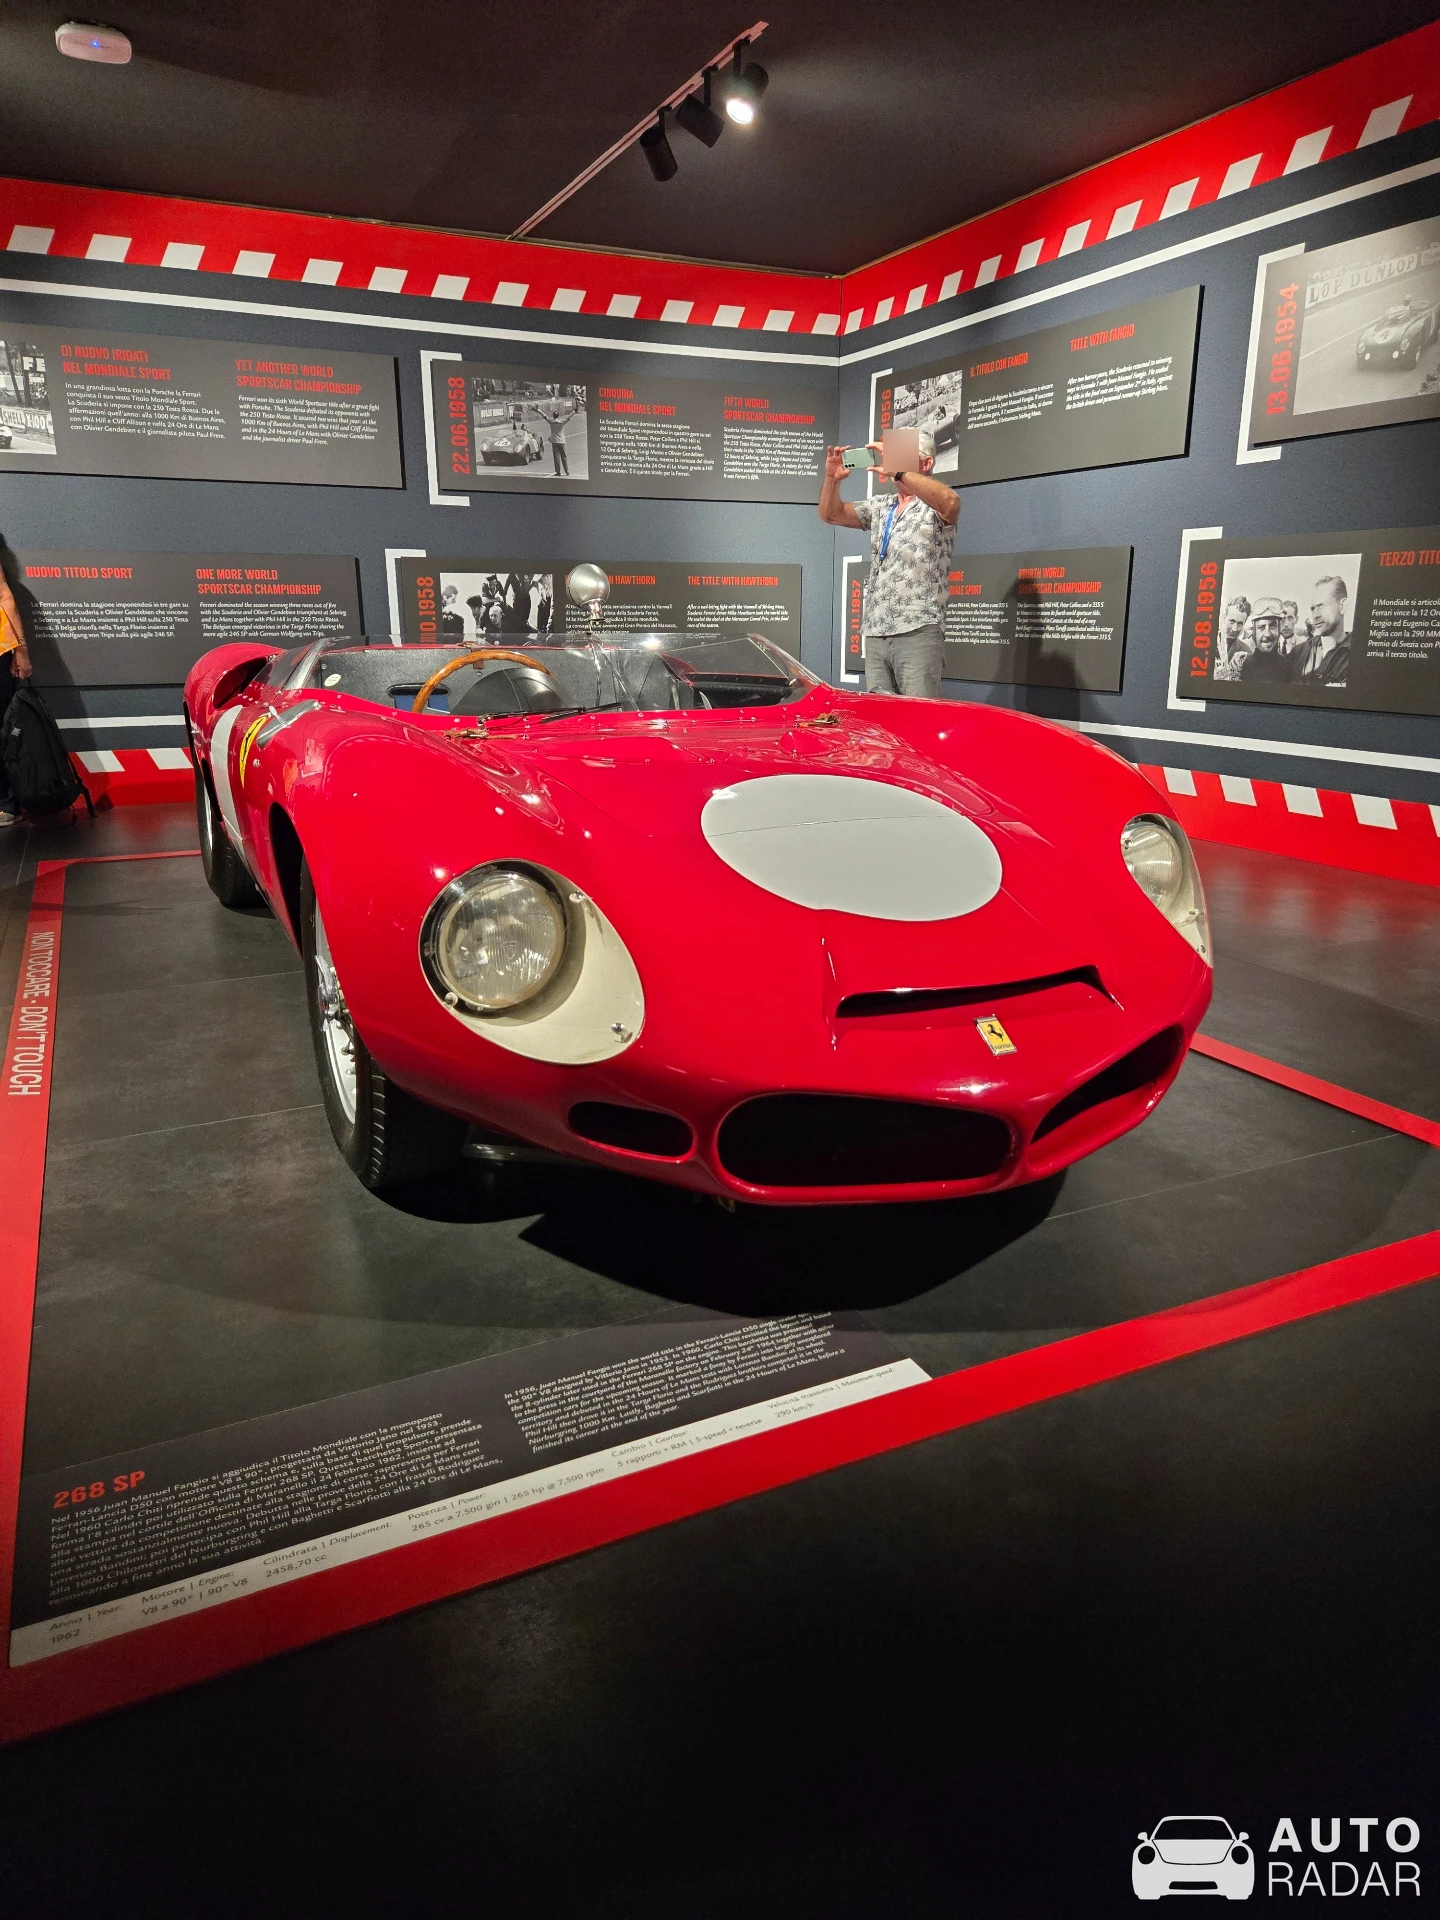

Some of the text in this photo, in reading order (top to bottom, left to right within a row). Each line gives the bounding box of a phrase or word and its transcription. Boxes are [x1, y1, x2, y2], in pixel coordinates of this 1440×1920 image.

[1350, 256, 1415, 288] DUNLOP
[1070, 323, 1135, 352] TITLE WITH FANGIO
[61, 345, 149, 362] DI NUOVO IRIDATI
[1266, 282, 1299, 416] 13.06.1954
[63, 361, 171, 381] NEL MONDIALE SPORT
[235, 359, 334, 378] YET ANOTHER WORLD
[975, 362, 995, 377] TITOLO
[995, 358, 1007, 371] CON
[1007, 352, 1029, 368] FANGIO
[65, 382, 71, 390] In
[86, 384, 116, 394] grandiosa
[145, 387, 150, 395] la
[152, 388, 175, 396] Porsche
[176, 389, 181, 397] la
[182, 390, 201, 398] Ferrari
[236, 375, 361, 395] SPORTSCAR CHAMPIONSHIP
[599, 387, 634, 399] CINQUINA
[599, 401, 676, 416] NEL MONDIALE SPORT
[723, 396, 769, 409] FIFTH WORLD
[448, 377, 470, 475] 22.06.1958
[723, 410, 815, 425] SPORTSCAR CHAMPIONSHIP
[1380, 551, 1415, 566] TERZO
[26, 566, 133, 579] NUOVO TITOLO SPORT
[196, 569, 278, 580] ONE MORE WORLD
[615, 576, 656, 585] HAWTHORN
[688, 576, 779, 586] THE TITLE WITH HAWTHORN
[1018, 567, 1065, 579] FOURTH WORLD
[198, 584, 322, 595] SPORTSCAR CHAMPIONSHIP
[1018, 582, 1102, 595] SPORTSCAR CHAMPIONSHIP
[850, 579, 861, 654] 03.11.1957
[1190, 561, 1218, 677] 12.08.1956
[1370, 620, 1392, 628] Fangio
[1403, 620, 1429, 628] Eugenio
[1369, 630, 1389, 638] Miglia
[1409, 651, 1428, 659] titolo.
[8, 931, 55, 1096] NON TOCCARE DON'T TOUCH
[774, 1402, 813, 1419] 290 km/h
[611, 1430, 688, 1457] Cambio Gearbox:
[617, 1460, 623, 1468] 5
[625, 1449, 661, 1466] rapporti
[671, 1441, 686, 1451] RM
[695, 1429, 726, 1444] 5-speed
[735, 1419, 762, 1430] reverse
[53, 1470, 147, 1509] 268 SP
[407, 1493, 485, 1520] Potenza Power:
[411, 1521, 430, 1532] 265
[434, 1517, 444, 1525] cv
[486, 1499, 500, 1511] giri
[511, 1490, 529, 1501] 265
[532, 1485, 544, 1496] hp
[585, 1468, 604, 1479] rpm
[262, 1522, 392, 1565] Cilindrata Displacement:
[265, 1553, 326, 1577] 2458,70 cc
[141, 1571, 233, 1603] Motore Engine:
[142, 1605, 157, 1616] V8
[232, 1578, 247, 1588] V8
[50, 1616, 82, 1630] Anno
[51, 1629, 80, 1643] 1962
